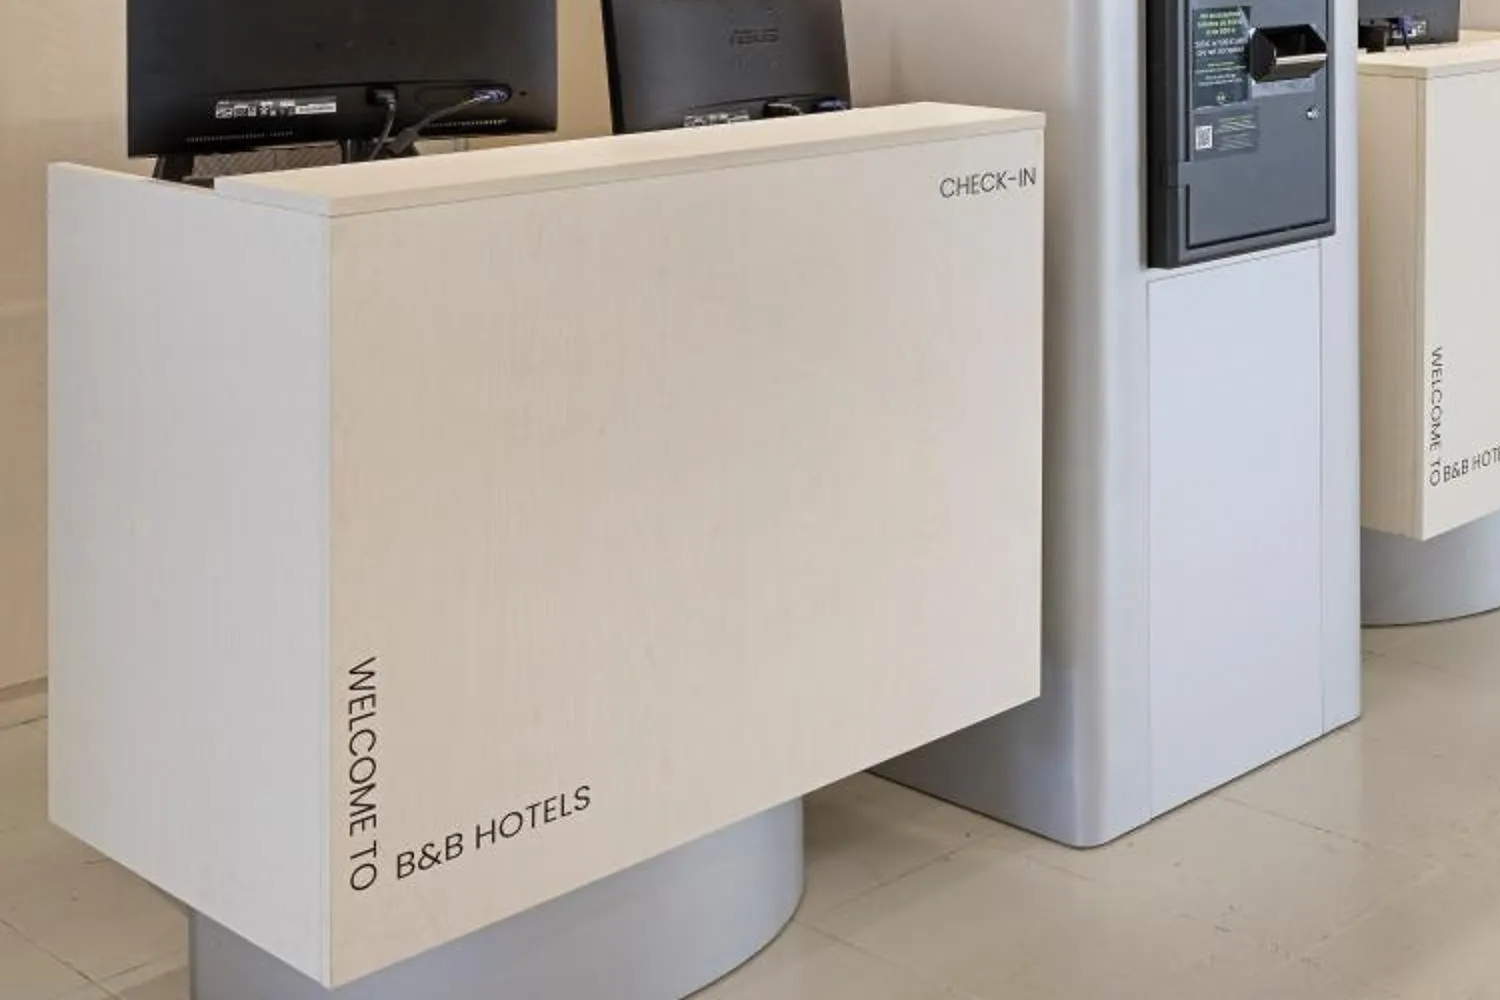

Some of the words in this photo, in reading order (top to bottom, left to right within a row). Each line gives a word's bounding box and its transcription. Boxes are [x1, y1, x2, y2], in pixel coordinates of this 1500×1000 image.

[940, 167, 1036, 198] CHECK-IN
[1430, 346, 1443, 452] WELCOME
[1429, 457, 1441, 487] TO
[1443, 458, 1469, 482] B&B
[348, 656, 377, 837] WELCOME
[396, 832, 464, 880] B&B
[475, 785, 592, 850] HOTELS
[350, 839, 377, 890] TO
